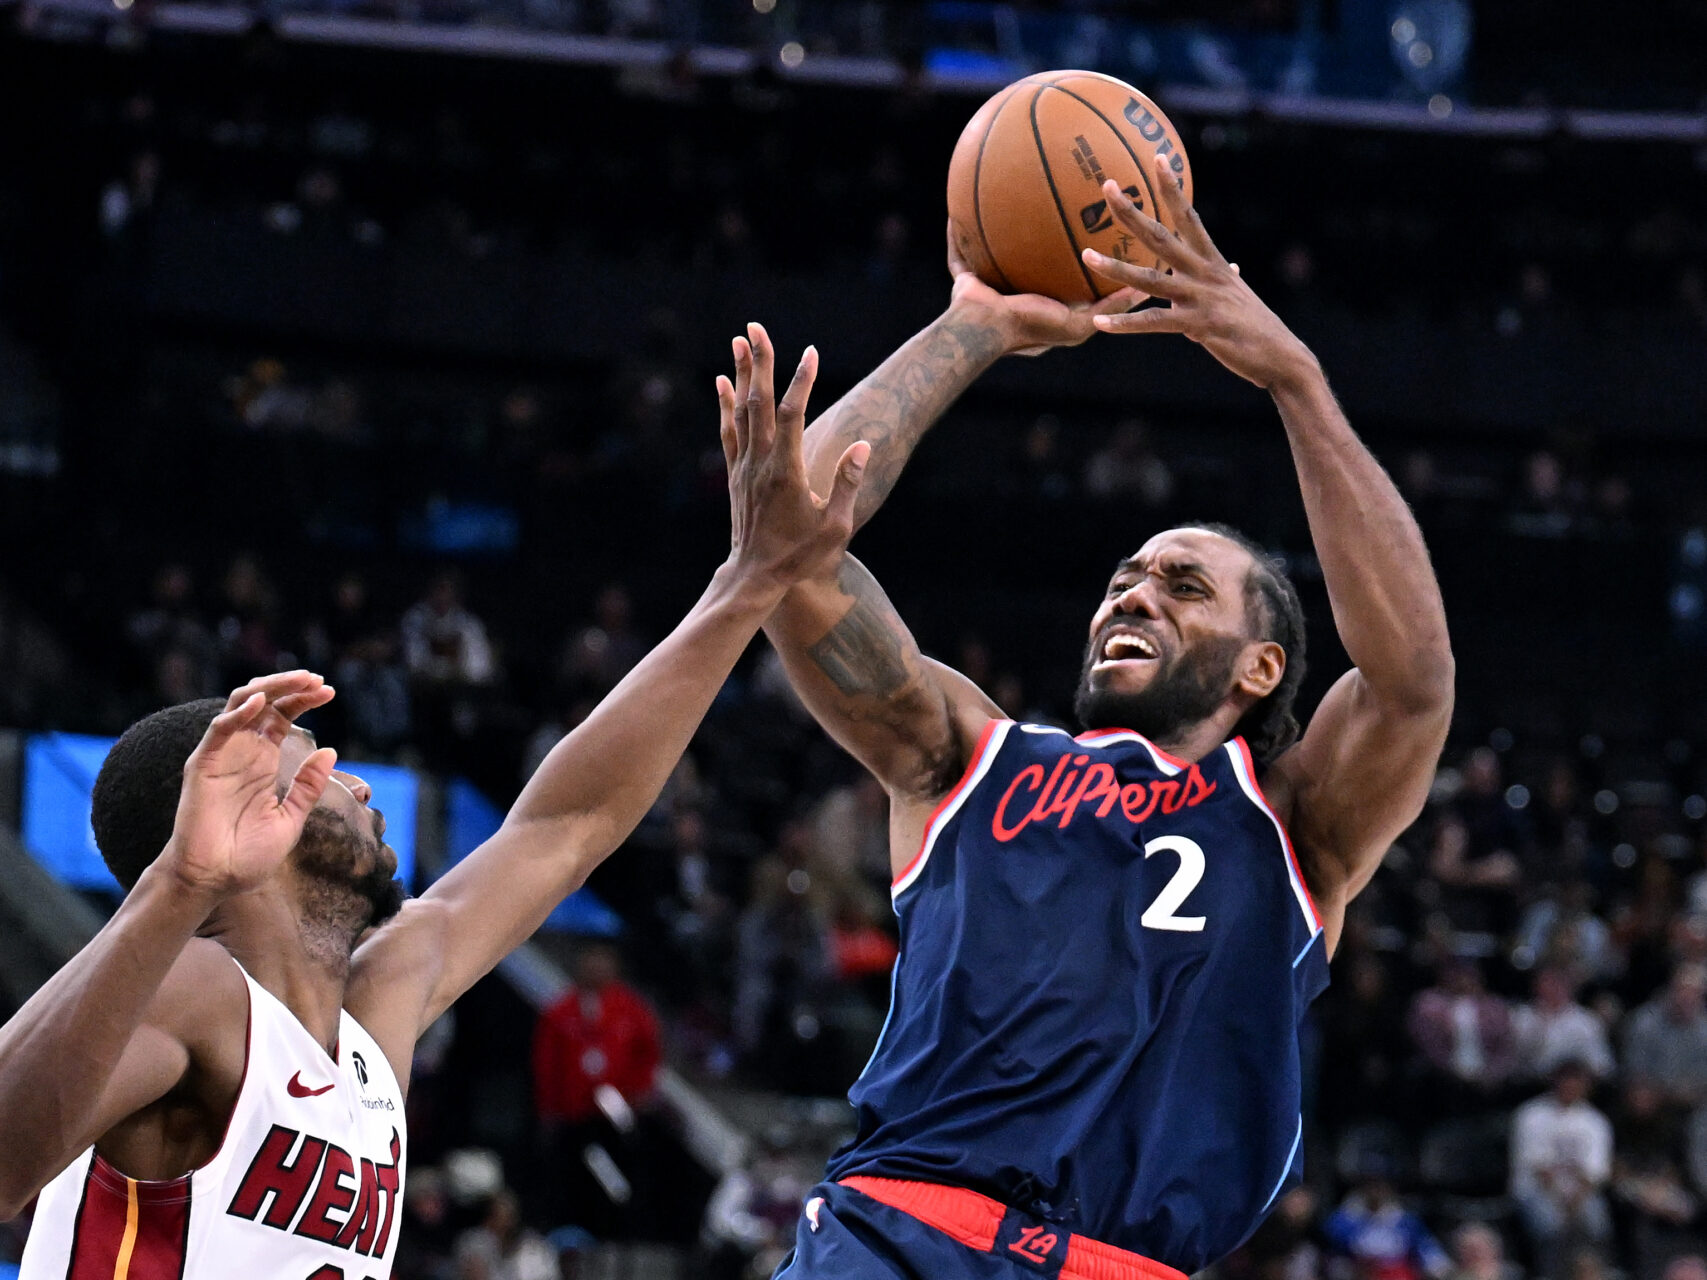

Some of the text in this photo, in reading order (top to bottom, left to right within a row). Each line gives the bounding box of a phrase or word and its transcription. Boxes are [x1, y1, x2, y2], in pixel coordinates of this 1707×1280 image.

[1141, 835, 1207, 932] 2
[226, 1124, 400, 1259] HEAT
[1008, 1226, 1058, 1264] LA
